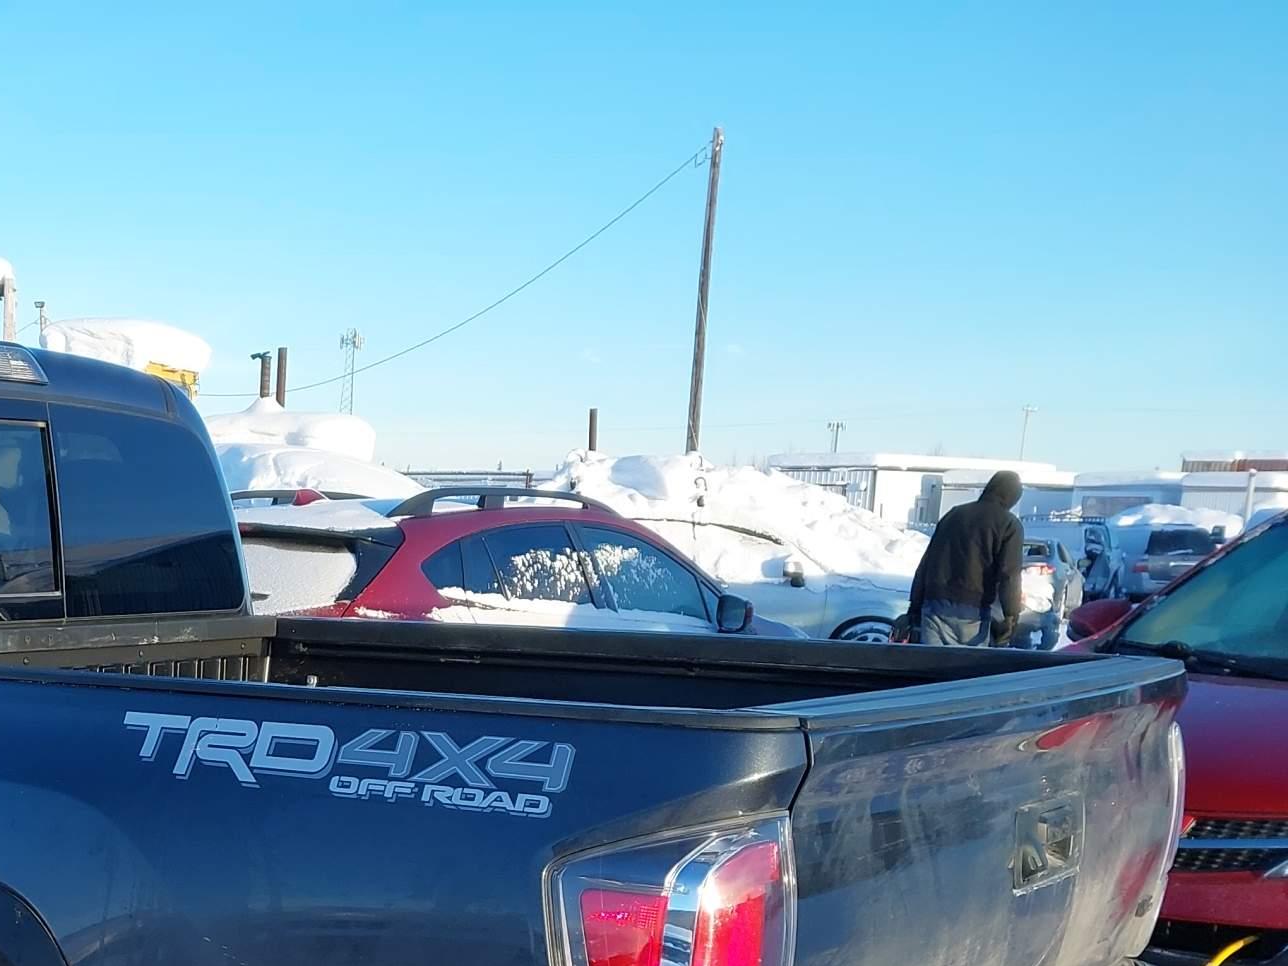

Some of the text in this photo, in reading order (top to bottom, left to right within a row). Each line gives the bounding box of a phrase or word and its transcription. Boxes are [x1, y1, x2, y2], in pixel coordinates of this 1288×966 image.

[124, 711, 338, 788] TRD
[329, 775, 553, 818] OFF ROAD
